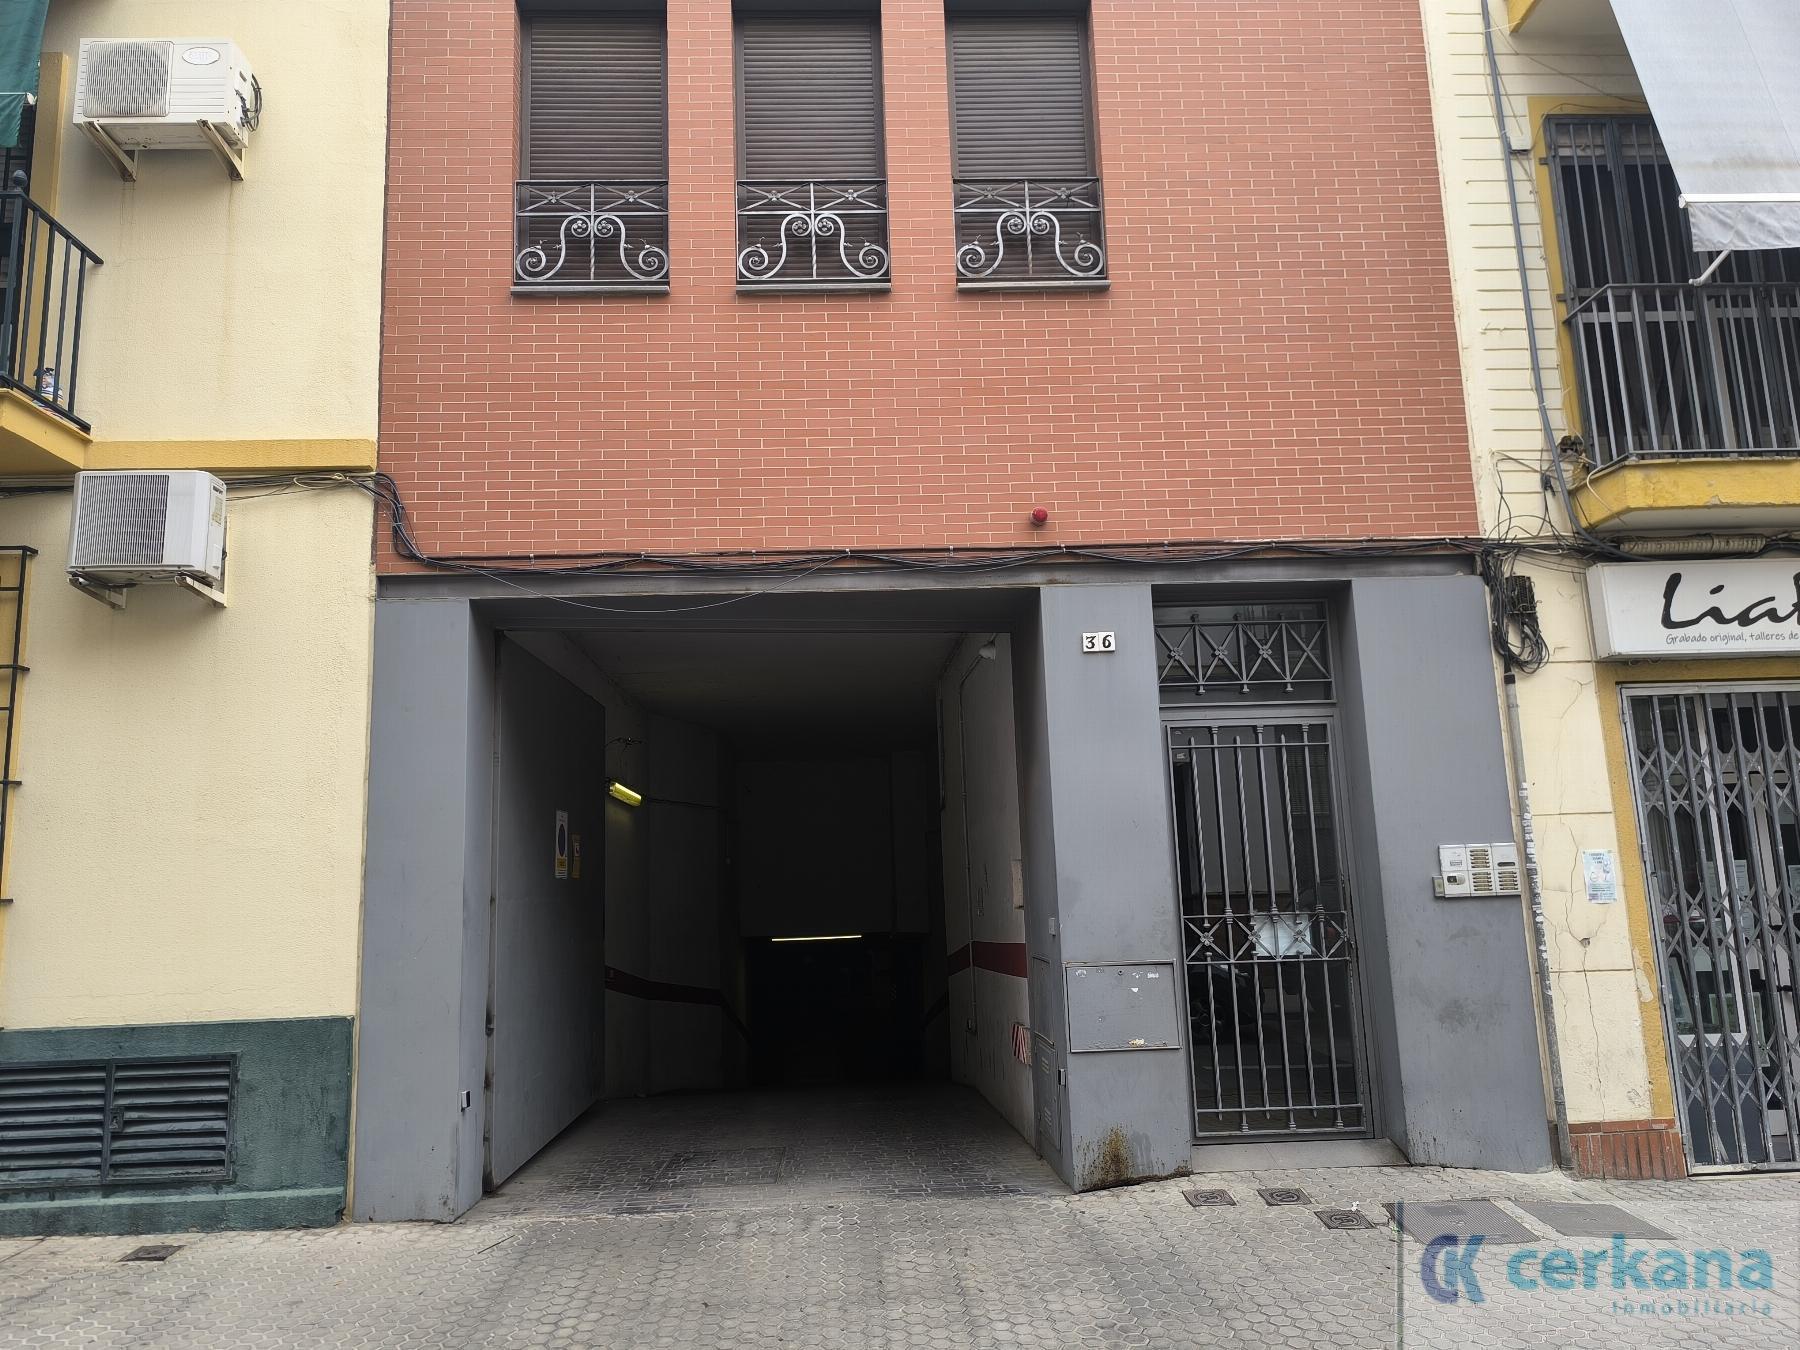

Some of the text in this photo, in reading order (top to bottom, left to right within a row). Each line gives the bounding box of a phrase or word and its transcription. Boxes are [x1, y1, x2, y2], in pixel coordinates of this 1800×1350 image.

[1085, 634, 1113, 650] 36
[1665, 630, 1800, 645] Grabado original, talleres de
